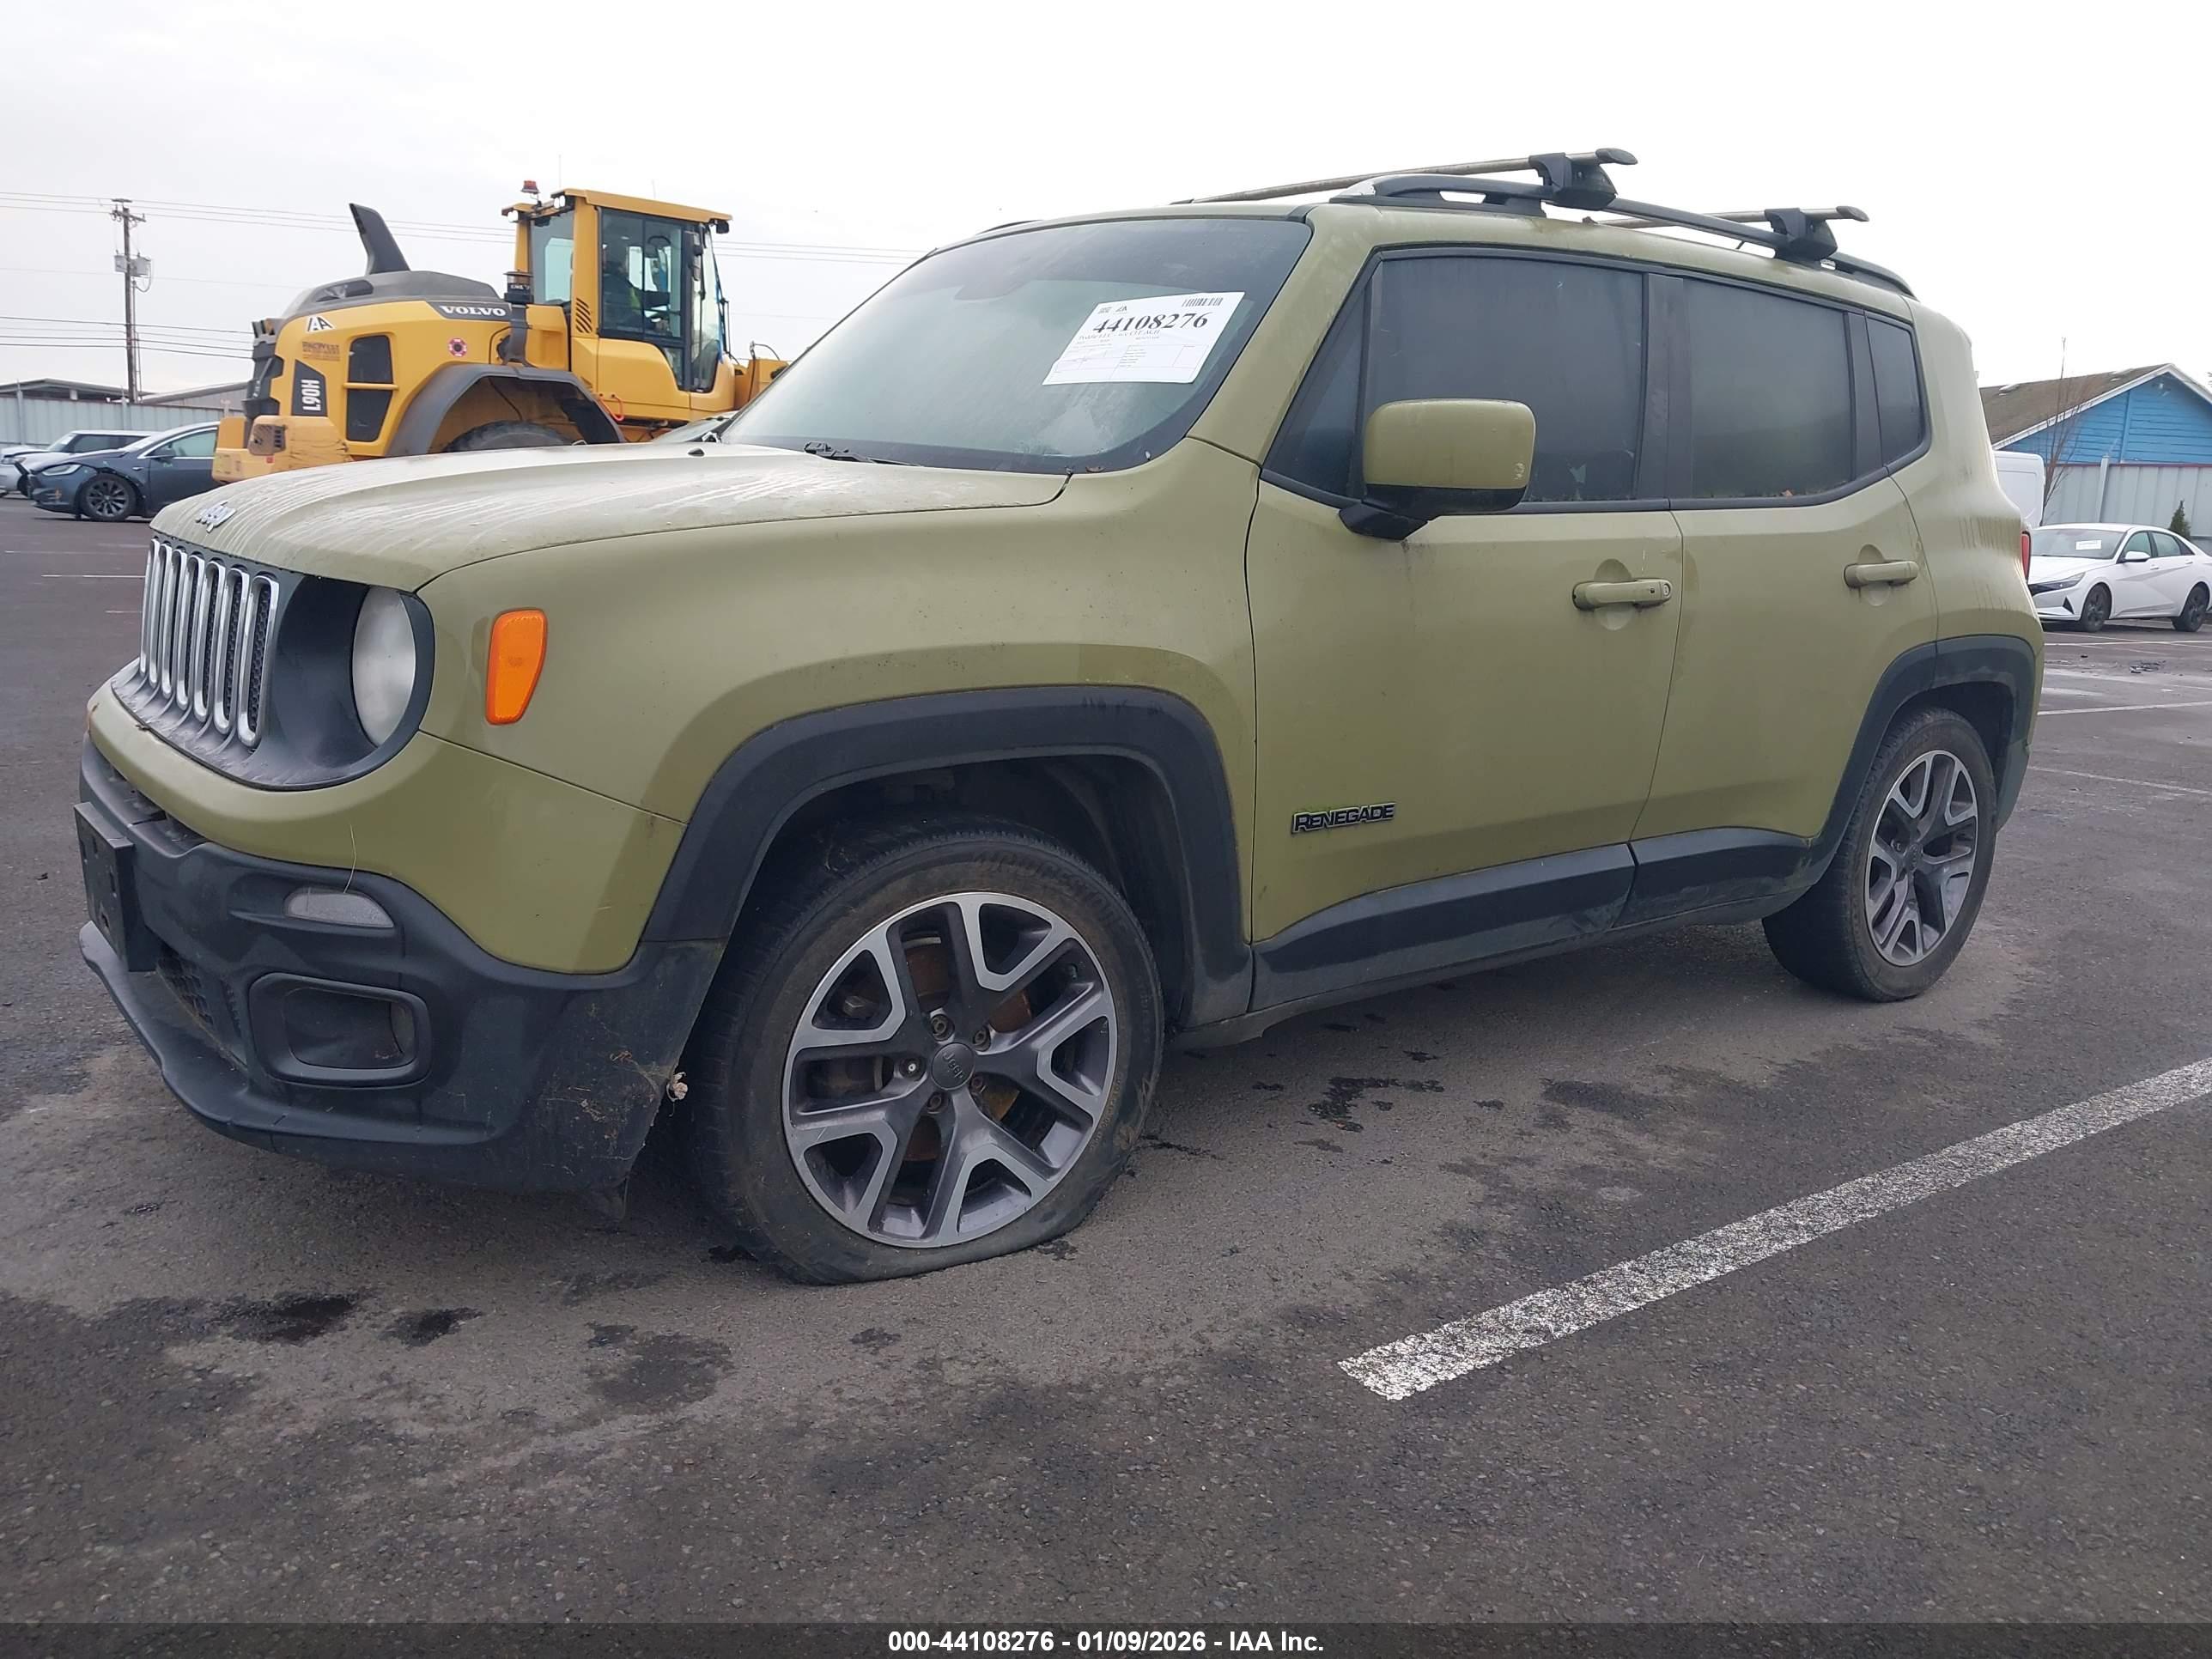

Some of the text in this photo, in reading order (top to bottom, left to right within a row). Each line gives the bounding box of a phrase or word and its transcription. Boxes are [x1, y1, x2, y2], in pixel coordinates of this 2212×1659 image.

[439, 305, 507, 317] VOLVO
[1092, 312, 1212, 333] 44108276
[301, 379, 322, 411] L90H
[1291, 801, 1397, 835] RENEGADE
[942, 1052, 966, 1079] Jeep
